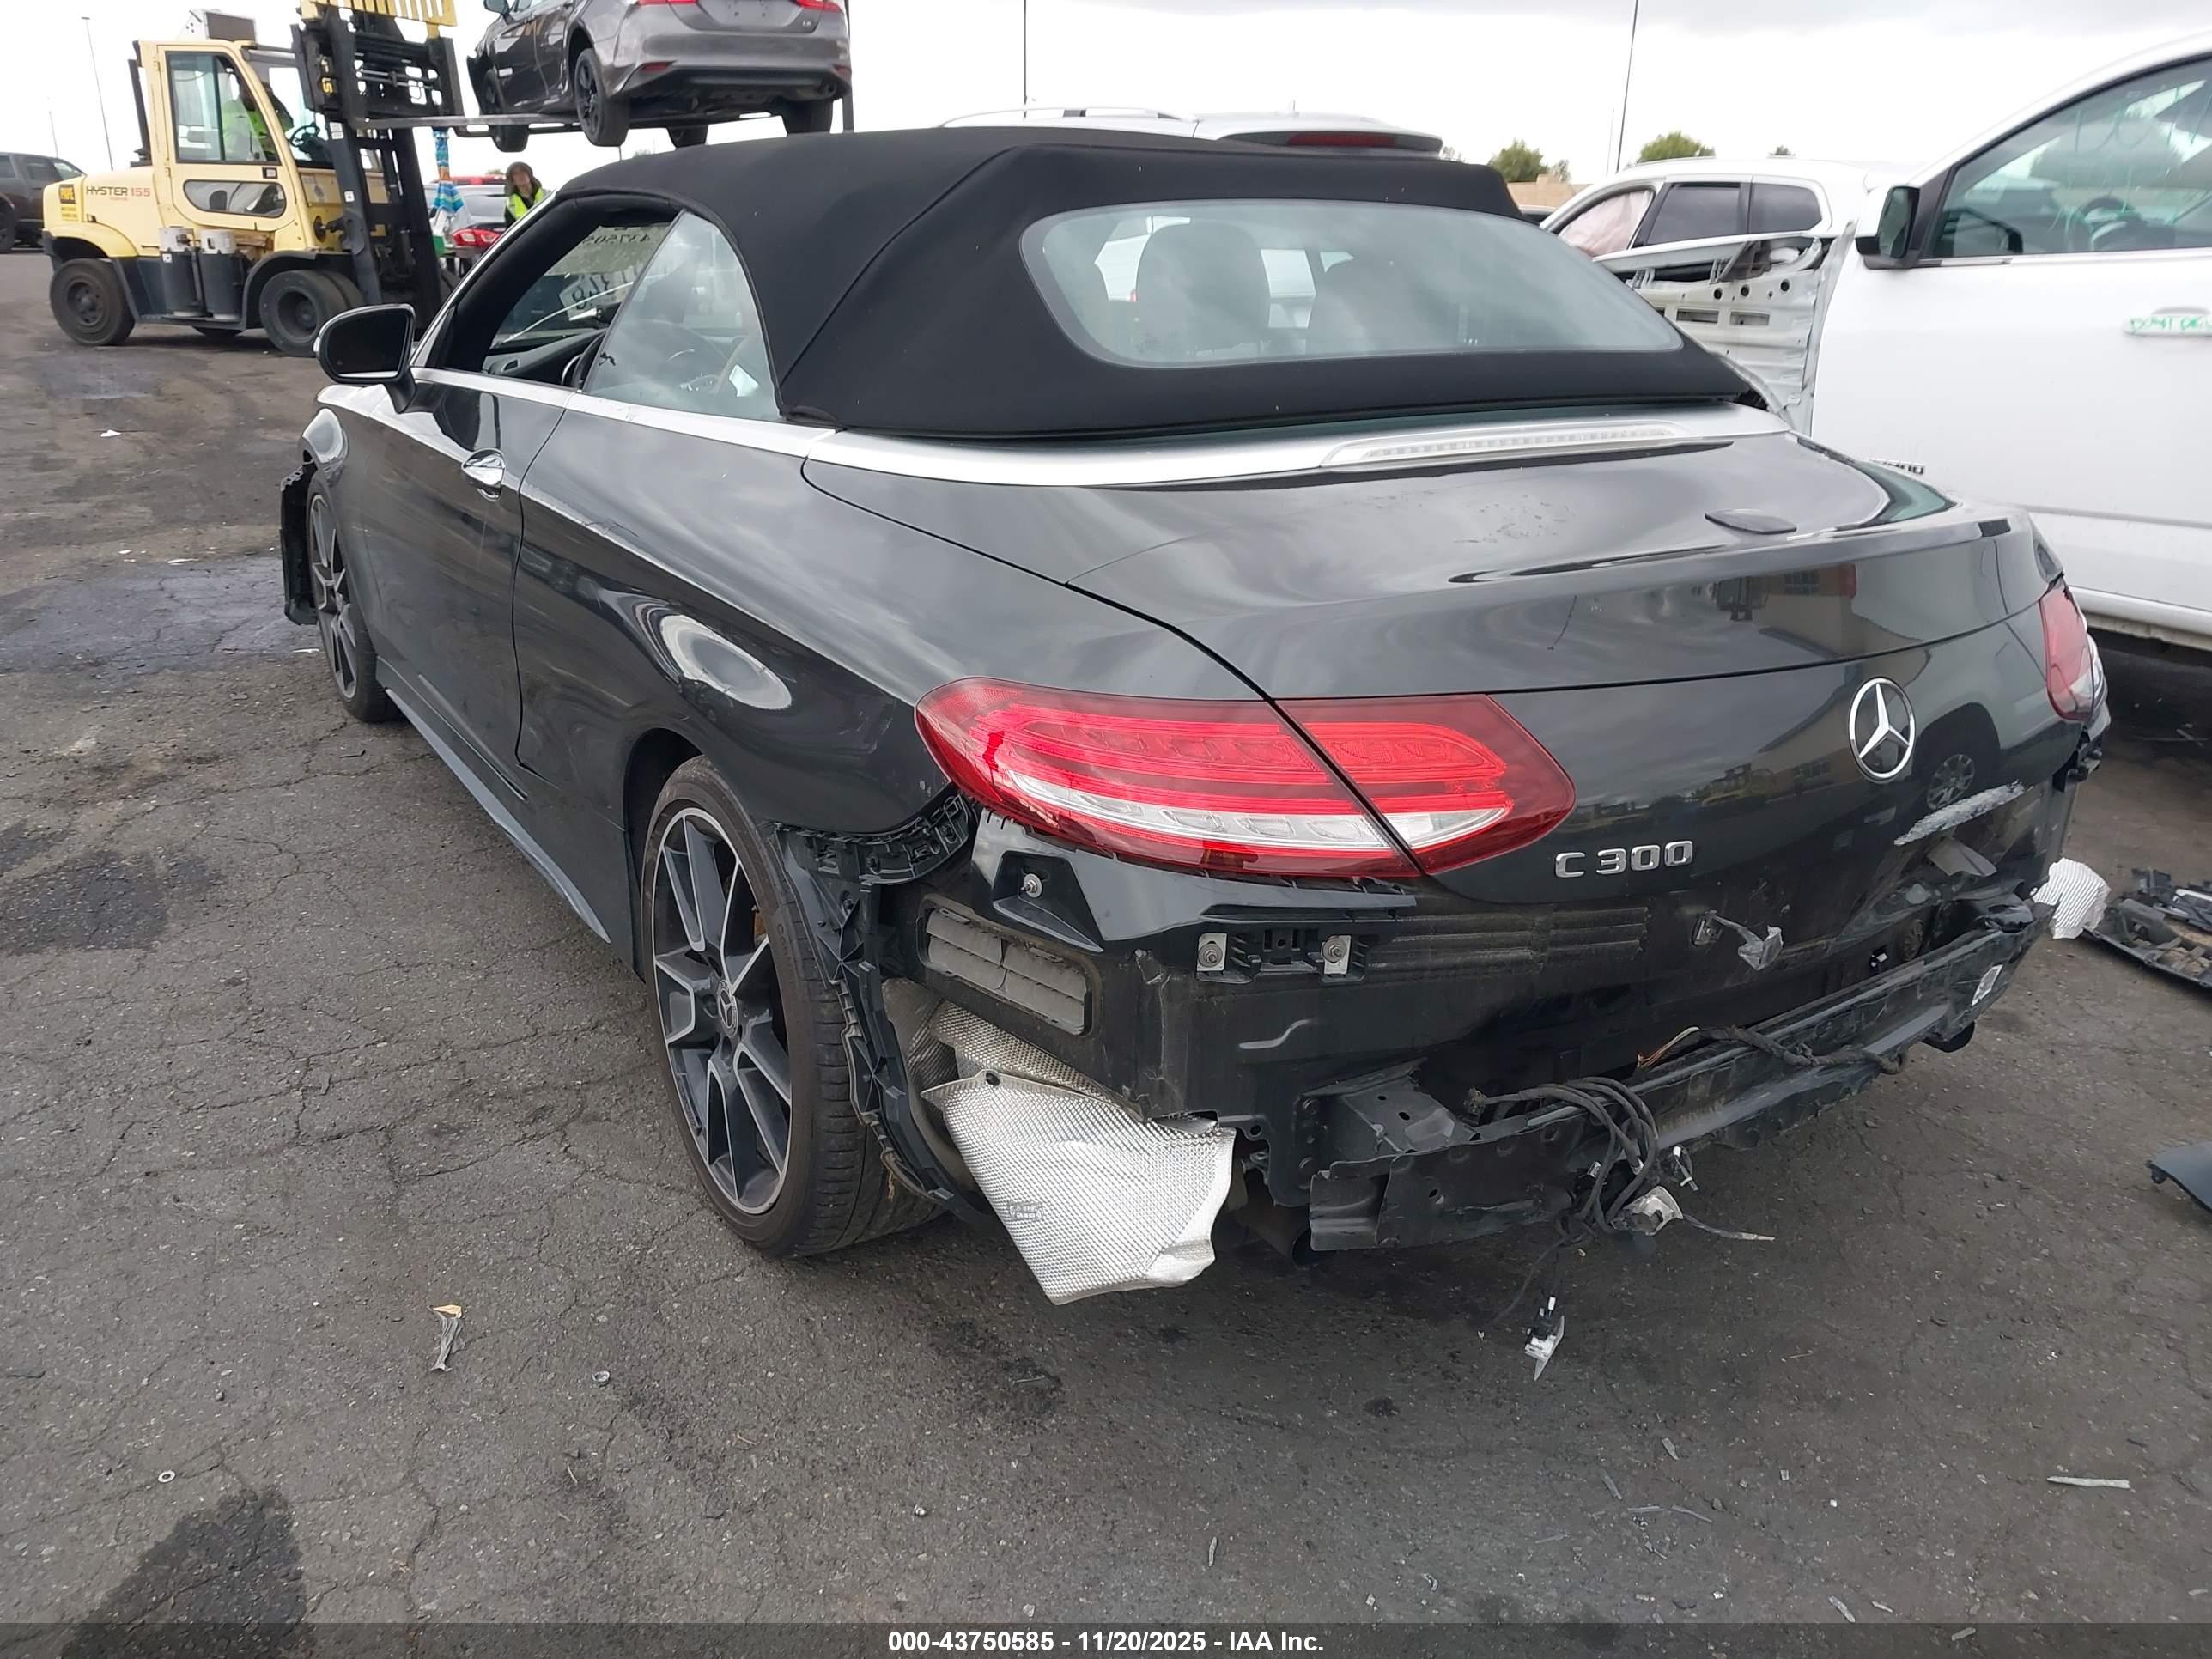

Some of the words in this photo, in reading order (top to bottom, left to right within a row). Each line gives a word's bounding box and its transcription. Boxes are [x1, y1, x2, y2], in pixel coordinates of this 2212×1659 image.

[86, 185, 128, 197] HYSTER
[131, 187, 151, 198] 155
[1555, 852, 1586, 878] C
[1595, 840, 1693, 875] 300
